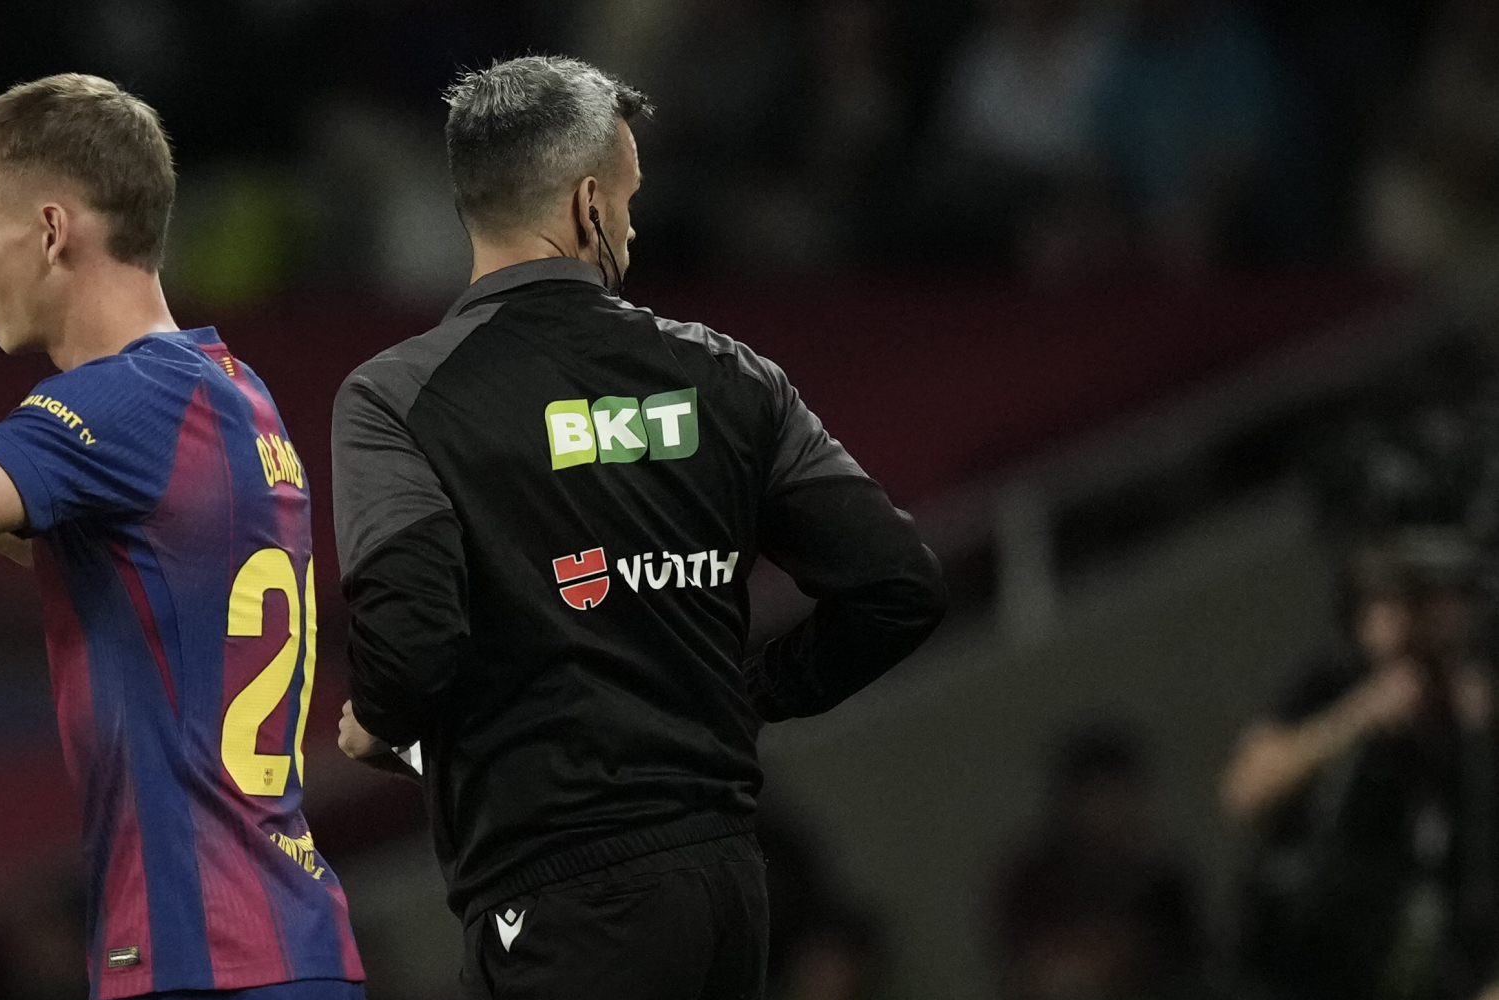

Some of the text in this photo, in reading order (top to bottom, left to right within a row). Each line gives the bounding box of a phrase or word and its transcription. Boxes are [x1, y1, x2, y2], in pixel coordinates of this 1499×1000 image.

[79, 428, 97, 445] tv
[550, 402, 692, 455] BKT
[221, 547, 317, 797] 2
